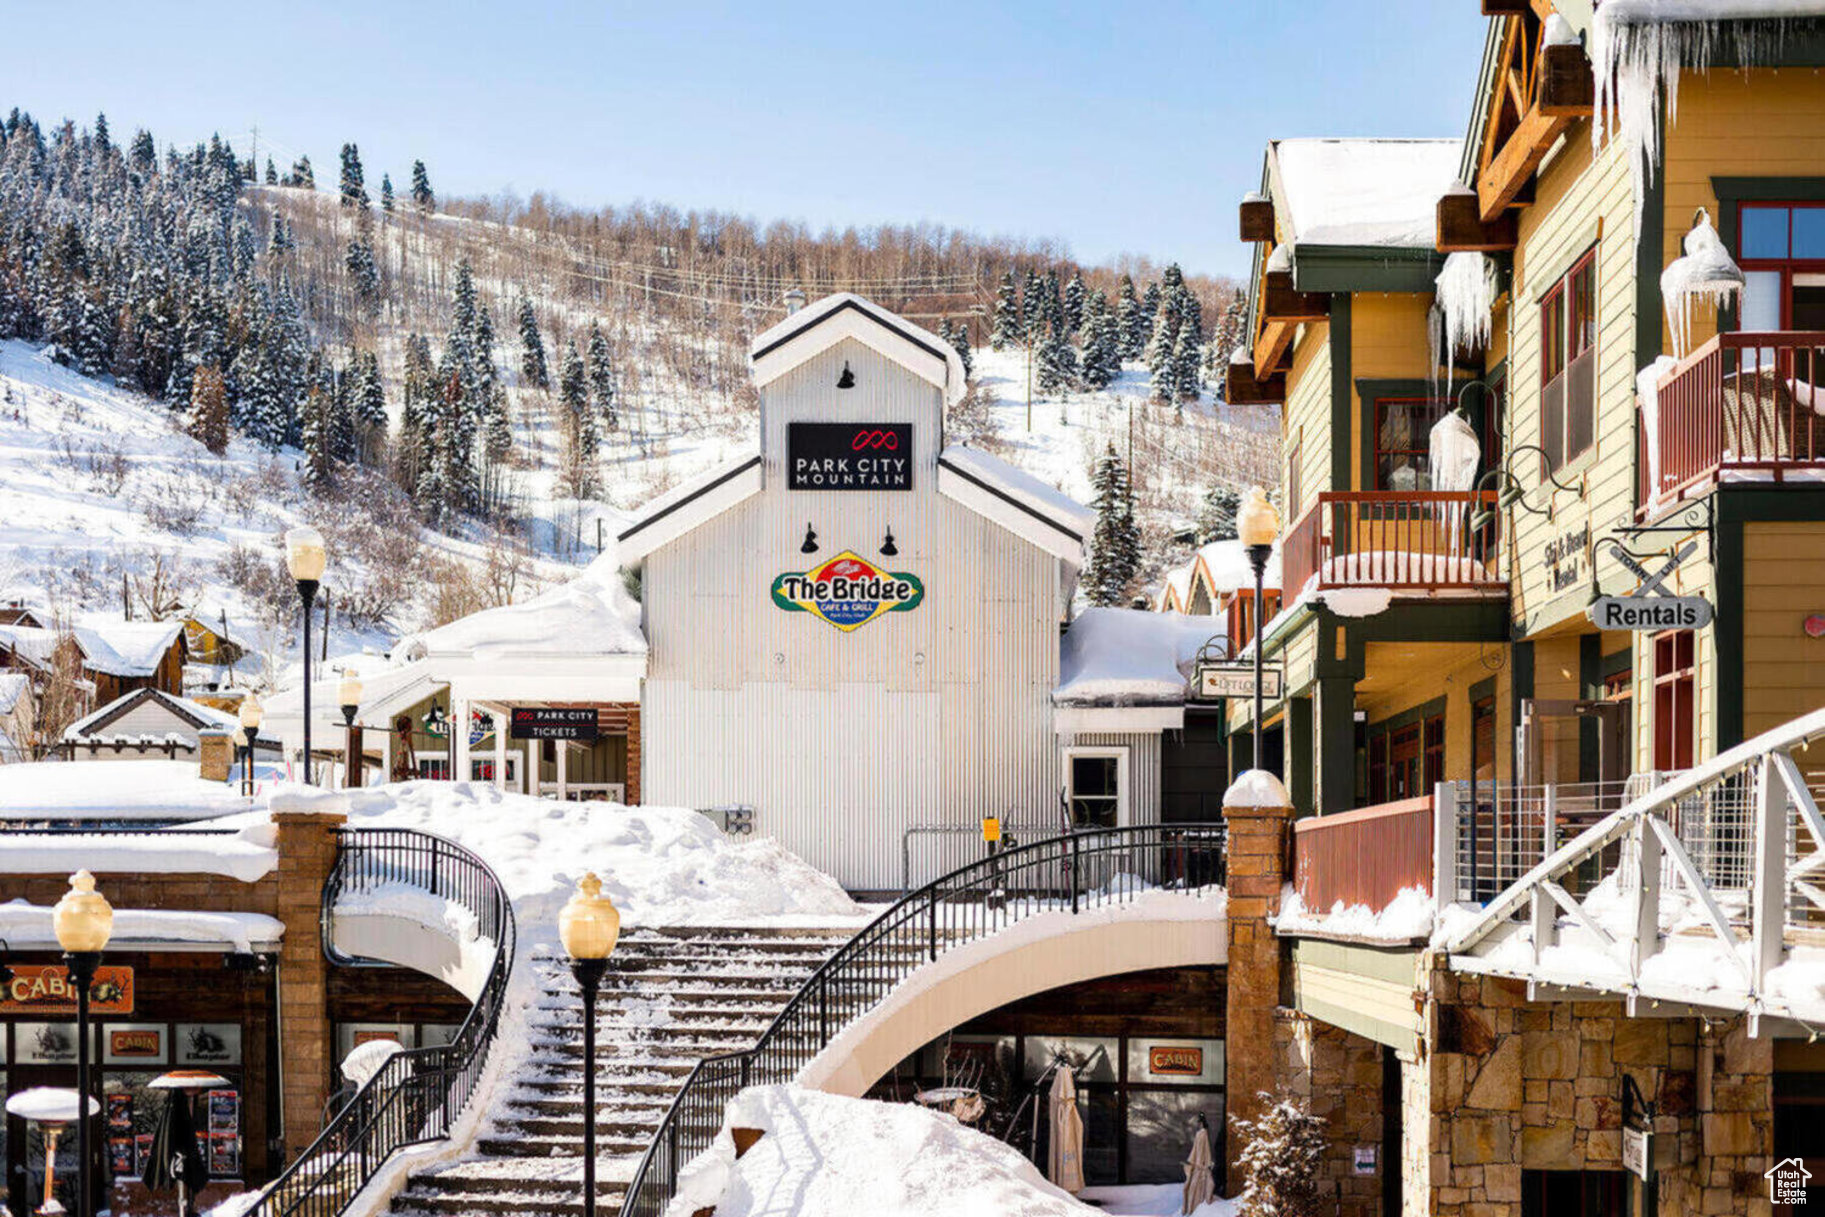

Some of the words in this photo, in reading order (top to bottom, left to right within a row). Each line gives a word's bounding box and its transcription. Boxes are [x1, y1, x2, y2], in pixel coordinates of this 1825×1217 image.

[796, 458, 848, 472] PARK
[857, 458, 905, 472] CITY
[796, 474, 904, 485] MOUNTAIN
[1619, 551, 1649, 582] TOWN
[1660, 555, 1682, 577] LIFT
[784, 577, 828, 600] The
[832, 577, 910, 600] Bridge
[1606, 602, 1697, 626] Rentals
[537, 711, 565, 720] PARK
[567, 711, 594, 720] CITY
[532, 727, 577, 737] TICKETS
[115, 1036, 156, 1050] CABIN
[1153, 1053, 1199, 1069] CABIN
